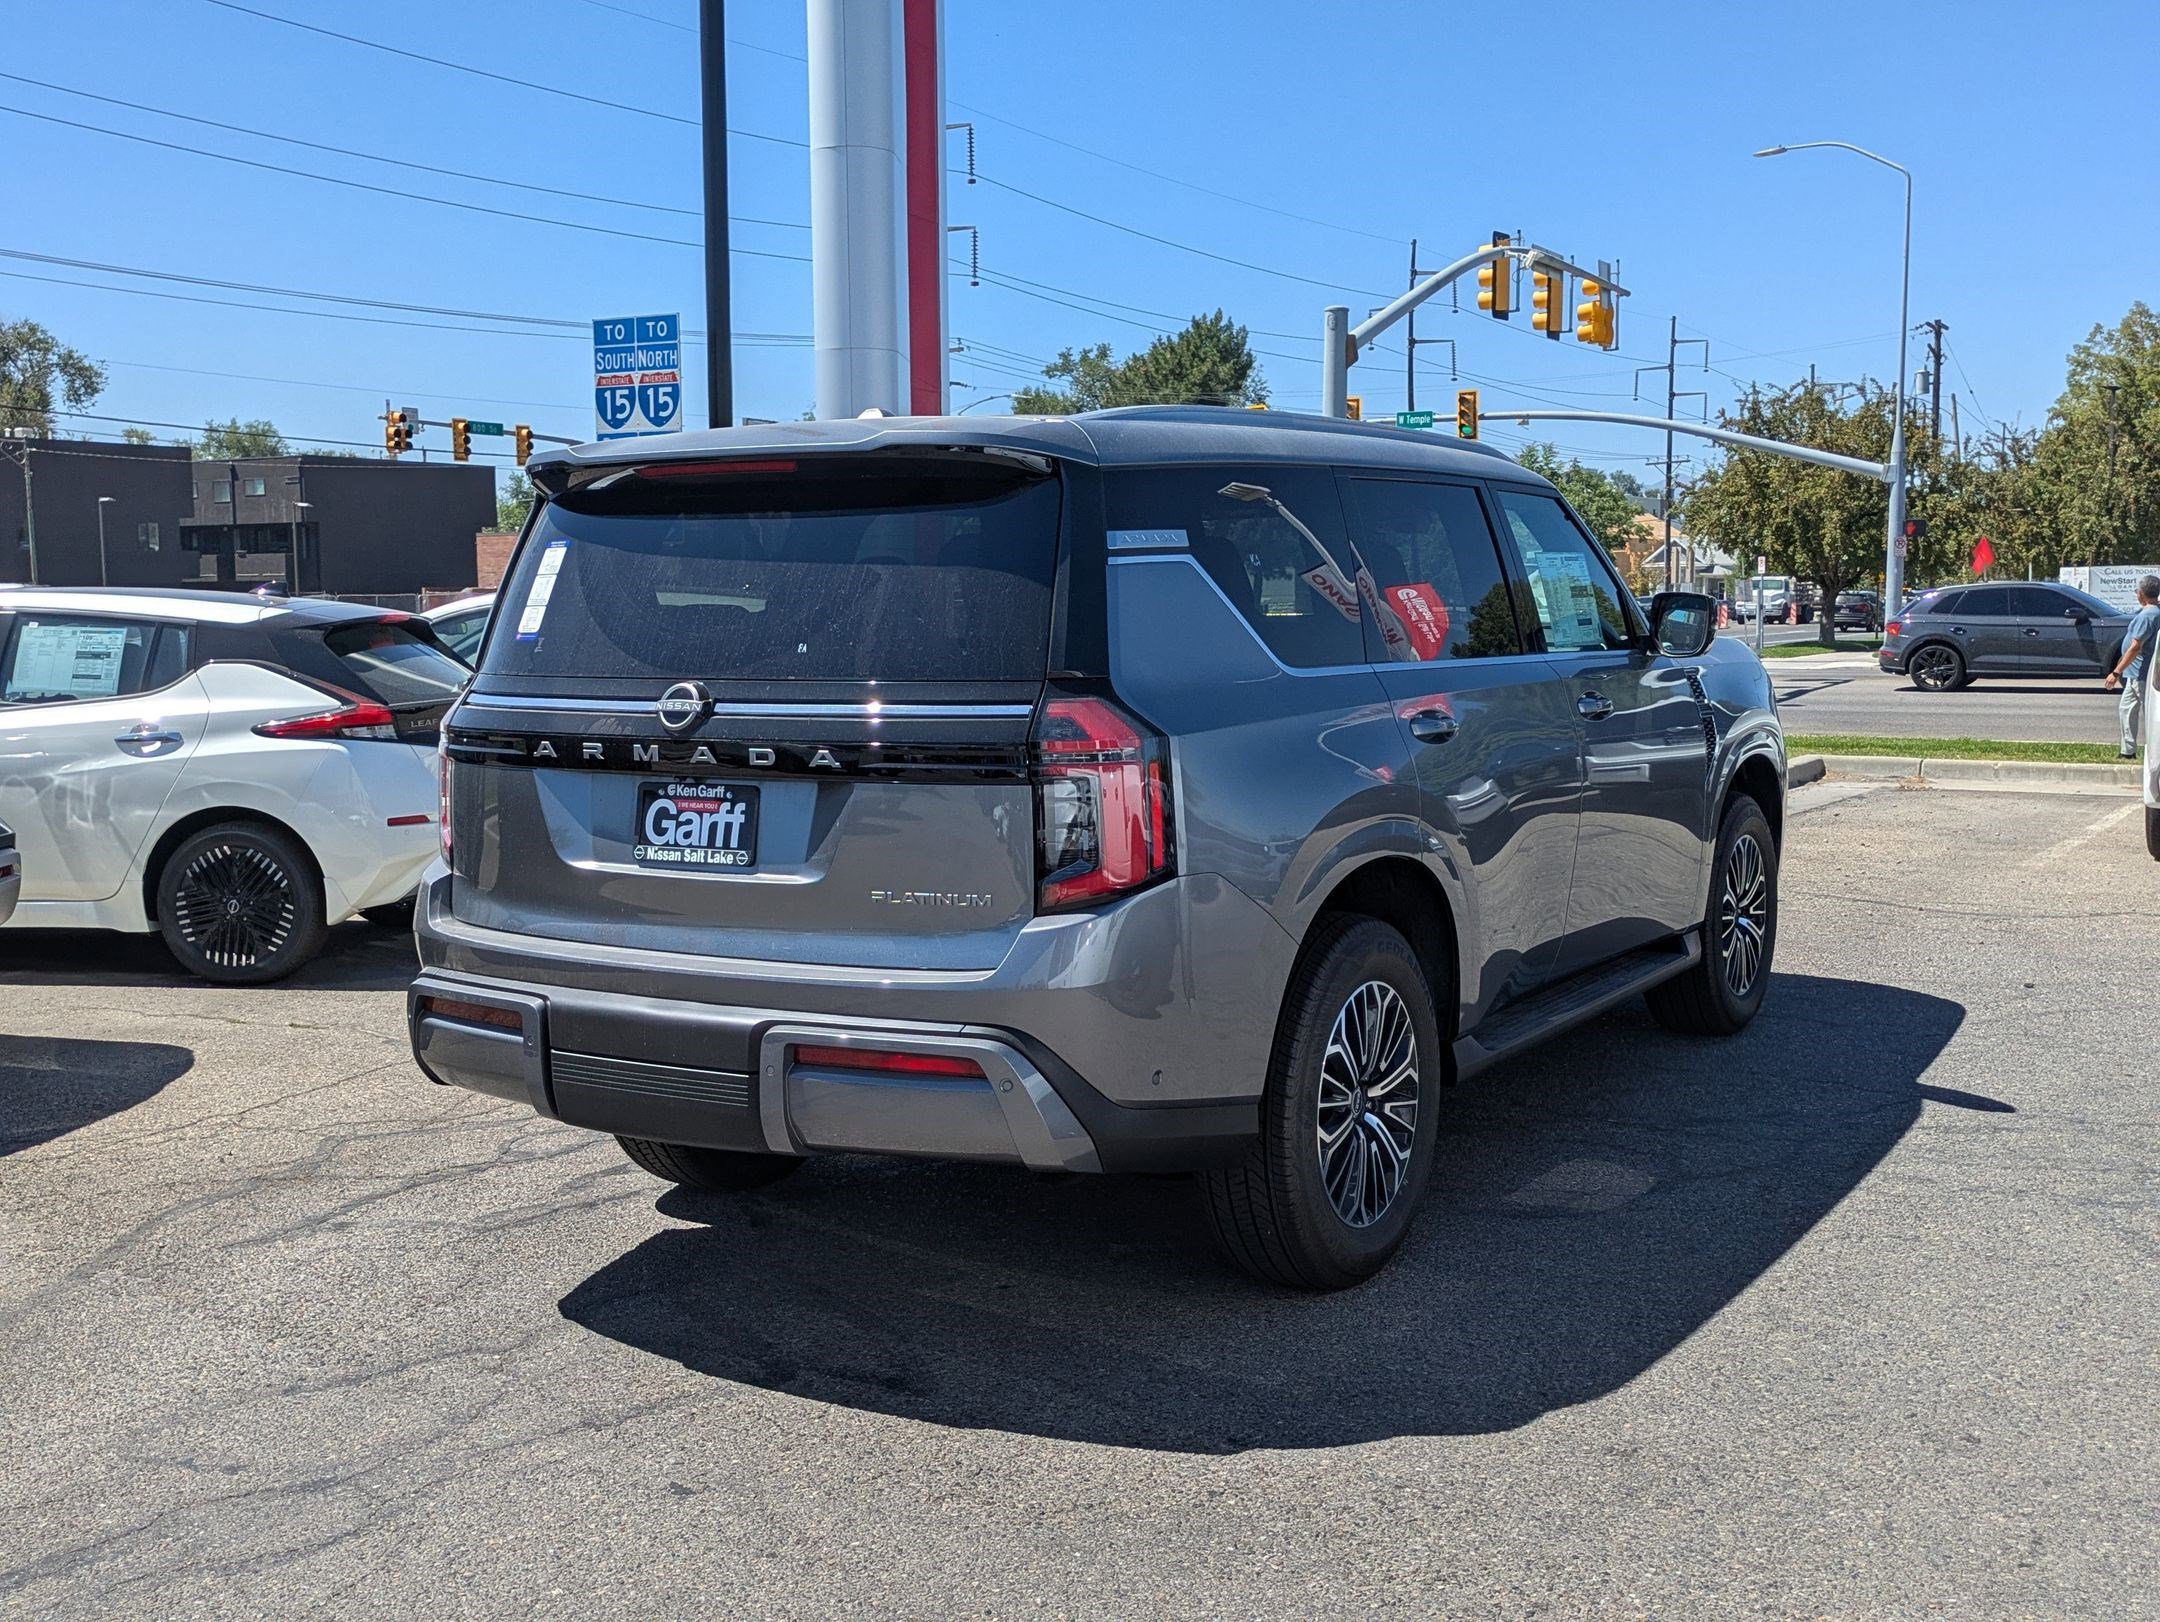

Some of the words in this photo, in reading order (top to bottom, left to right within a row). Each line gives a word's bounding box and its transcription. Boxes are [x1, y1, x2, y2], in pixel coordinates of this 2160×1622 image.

[604, 324, 625, 340] TO
[646, 321, 667, 337] TO
[596, 352, 635, 370] SOUTH
[638, 349, 678, 367] NORTH
[600, 376, 630, 385] INTERSTATE
[643, 373, 673, 383] INTERSTATE
[604, 389, 631, 420] 15
[647, 386, 674, 418] 15
[1398, 415, 1405, 424] W
[1406, 414, 1431, 426] Temple
[655, 702, 701, 711] NISSAN
[410, 718, 438, 728] LEAF
[533, 740, 842, 769] ARMADA
[676, 784, 697, 797] Ken
[697, 785, 725, 798] Garff
[645, 798, 746, 848] Garff
[647, 847, 681, 862] Nissan
[684, 849, 705, 863] Salt
[708, 850, 734, 864] Lake
[871, 890, 992, 907] PLATINUM
